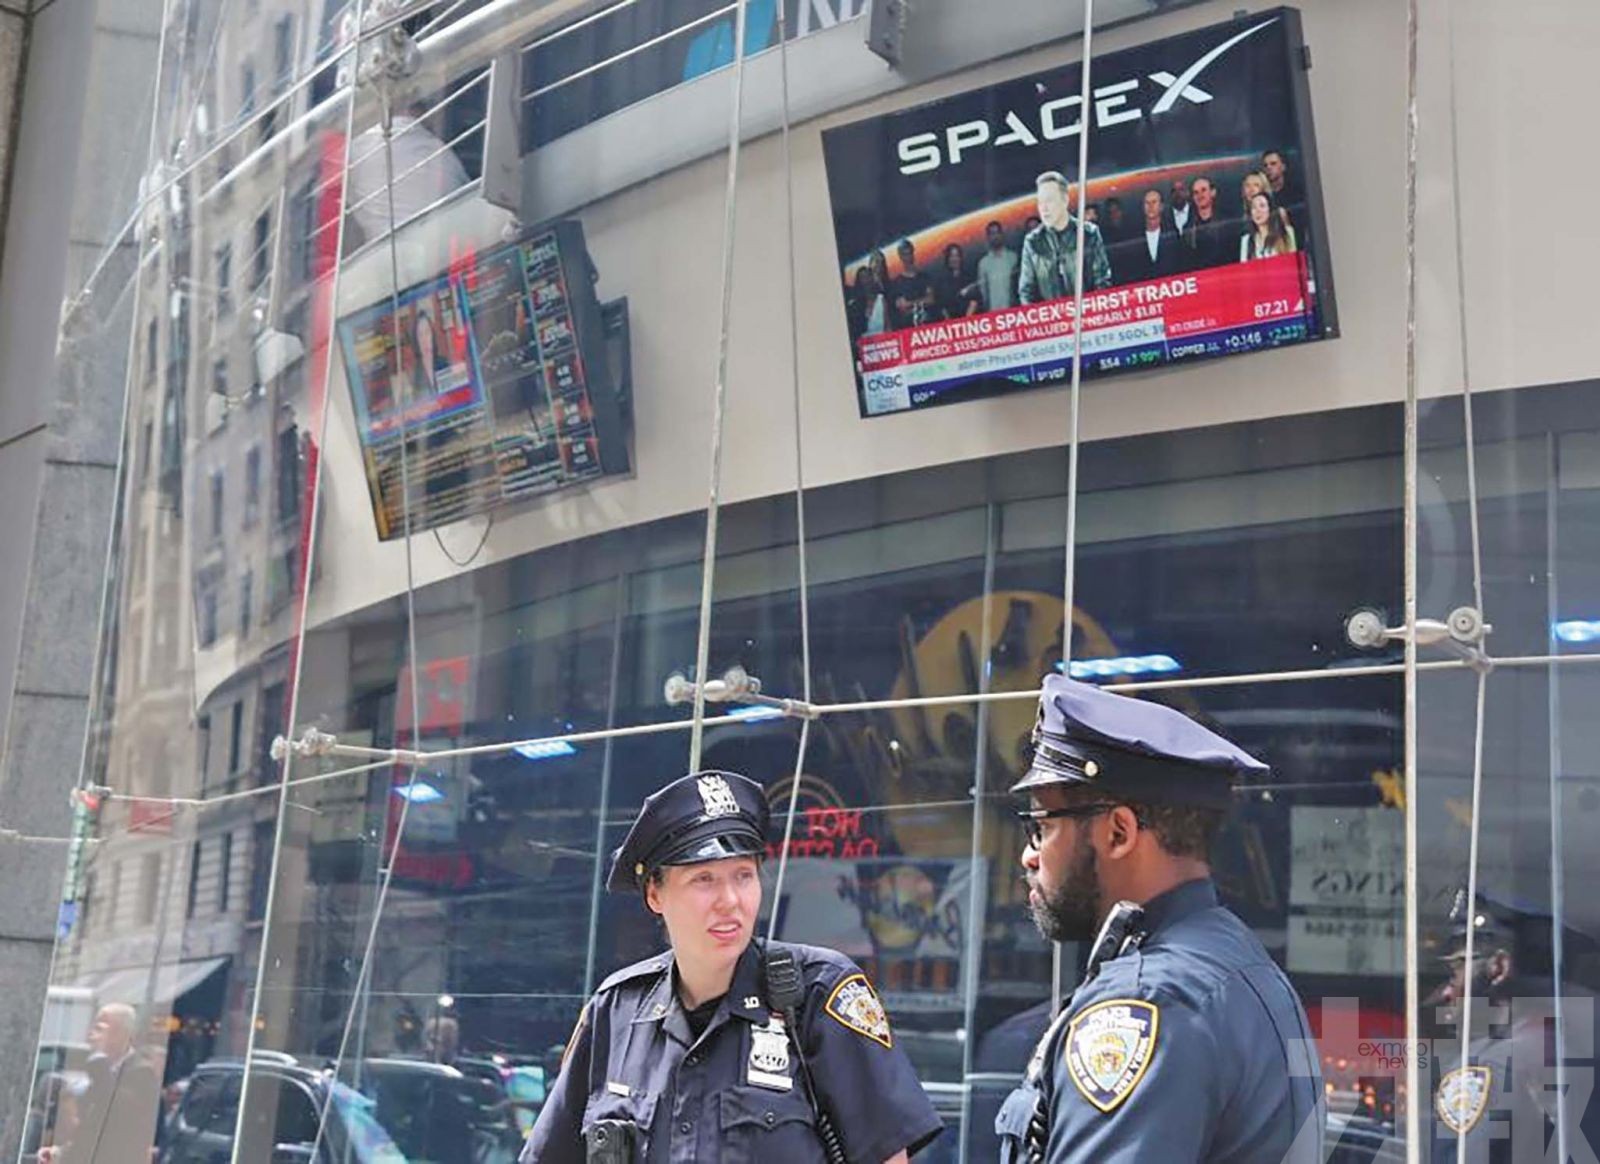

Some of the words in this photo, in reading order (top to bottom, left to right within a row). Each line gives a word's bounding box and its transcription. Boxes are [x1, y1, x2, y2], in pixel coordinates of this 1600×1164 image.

[898, 17, 1279, 175] SPACEX
[910, 318, 992, 347] AWAITING
[996, 300, 1077, 331] SPACEX'S
[1079, 290, 1131, 313] FIRST
[1135, 276, 1198, 302] TRADE
[1254, 300, 1289, 318] 87.21
[1024, 321, 1069, 339] VALUED
[863, 349, 900, 364] NEWS
